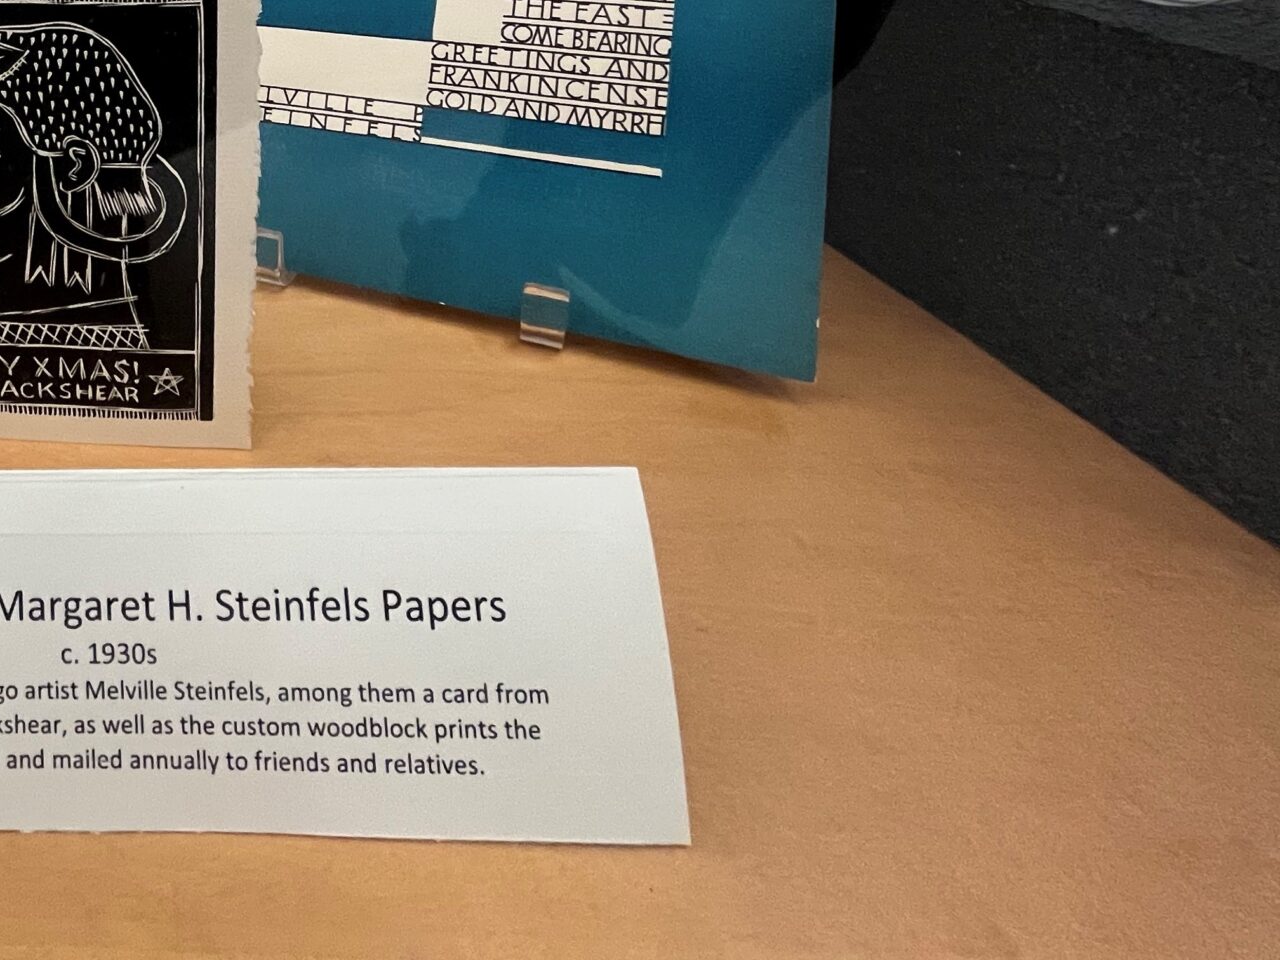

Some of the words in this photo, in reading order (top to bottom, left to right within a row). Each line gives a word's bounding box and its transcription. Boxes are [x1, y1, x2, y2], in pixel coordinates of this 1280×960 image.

[576, 1, 656, 28] EAST
[500, 22, 565, 44] COME
[431, 41, 591, 74] GREETINGS
[604, 59, 669, 83] AND
[428, 62, 669, 109] FRANKINCENSE
[426, 88, 498, 114] GOLD
[503, 97, 561, 123] AND
[566, 105, 666, 137] MYRRH
[33, 356, 140, 385] XMAS!
[167, 588, 203, 622] H.
[215, 586, 371, 623] Steinfels
[381, 588, 507, 631] Papers
[60, 647, 79, 665] c.
[87, 642, 158, 665] 1930s
[24, 679, 80, 701] artist
[85, 678, 168, 701] Melville
[173, 679, 271, 706] Steinfels,
[277, 686, 353, 708] among
[357, 680, 416, 704] them
[422, 687, 435, 704] a
[441, 682, 489, 704] card
[494, 681, 550, 705] from
[73, 718, 97, 735] as
[101, 713, 145, 735] well
[151, 719, 174, 736] as
[179, 713, 215, 736] the
[221, 717, 301, 737] custom
[306, 715, 429, 740] woodblock
[434, 718, 499, 745] prints
[503, 717, 541, 741] the
[6, 747, 45, 770] and
[52, 747, 123, 770] mailed
[129, 748, 220, 776] annually
[225, 751, 249, 772] to
[253, 749, 331, 773] friends
[336, 751, 377, 774] and
[384, 752, 485, 776] relatives.
